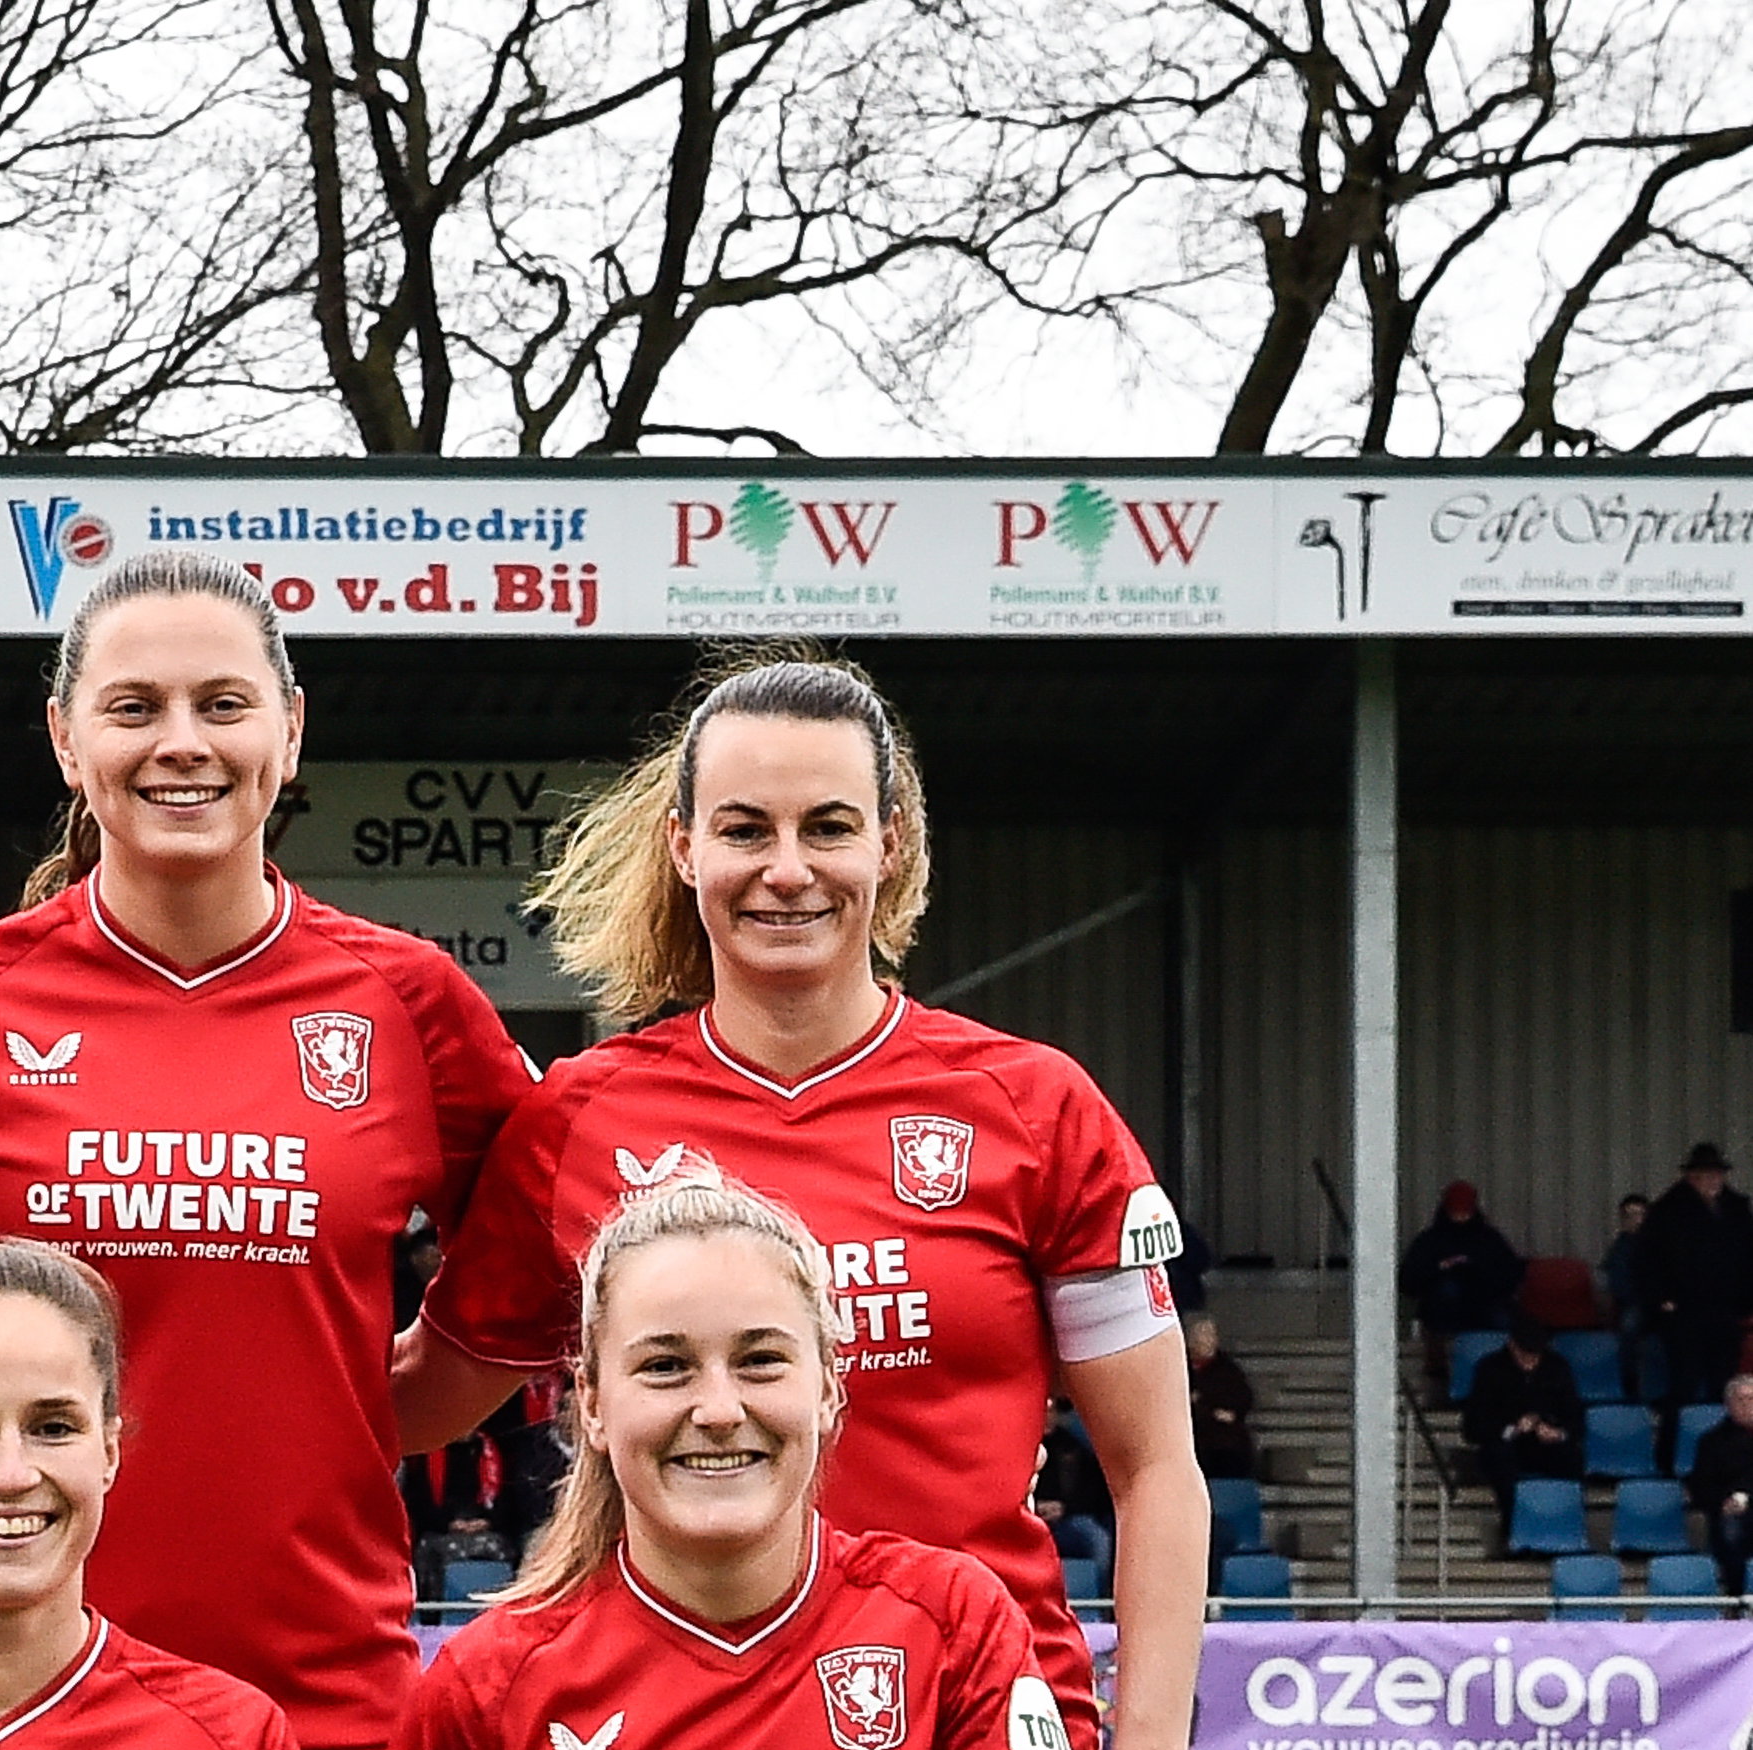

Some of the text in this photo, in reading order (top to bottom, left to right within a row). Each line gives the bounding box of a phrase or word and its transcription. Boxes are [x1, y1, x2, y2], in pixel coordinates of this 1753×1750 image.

[148, 507, 588, 551] installatiebedrijf
[336, 563, 477, 613] v.d.
[494, 562, 599, 627] Bij
[354, 817, 556, 867] SPART
[66, 1130, 307, 1183] FUTURE
[26, 1182, 320, 1238] OF TWENTE
[86, 1240, 179, 1257] vrouwen.
[184, 1241, 241, 1261] meer
[244, 1241, 311, 1265] kracht.
[1128, 1220, 1178, 1265] TOTO
[860, 1346, 933, 1371] kracht.
[1246, 1636, 1661, 1727] azerion
